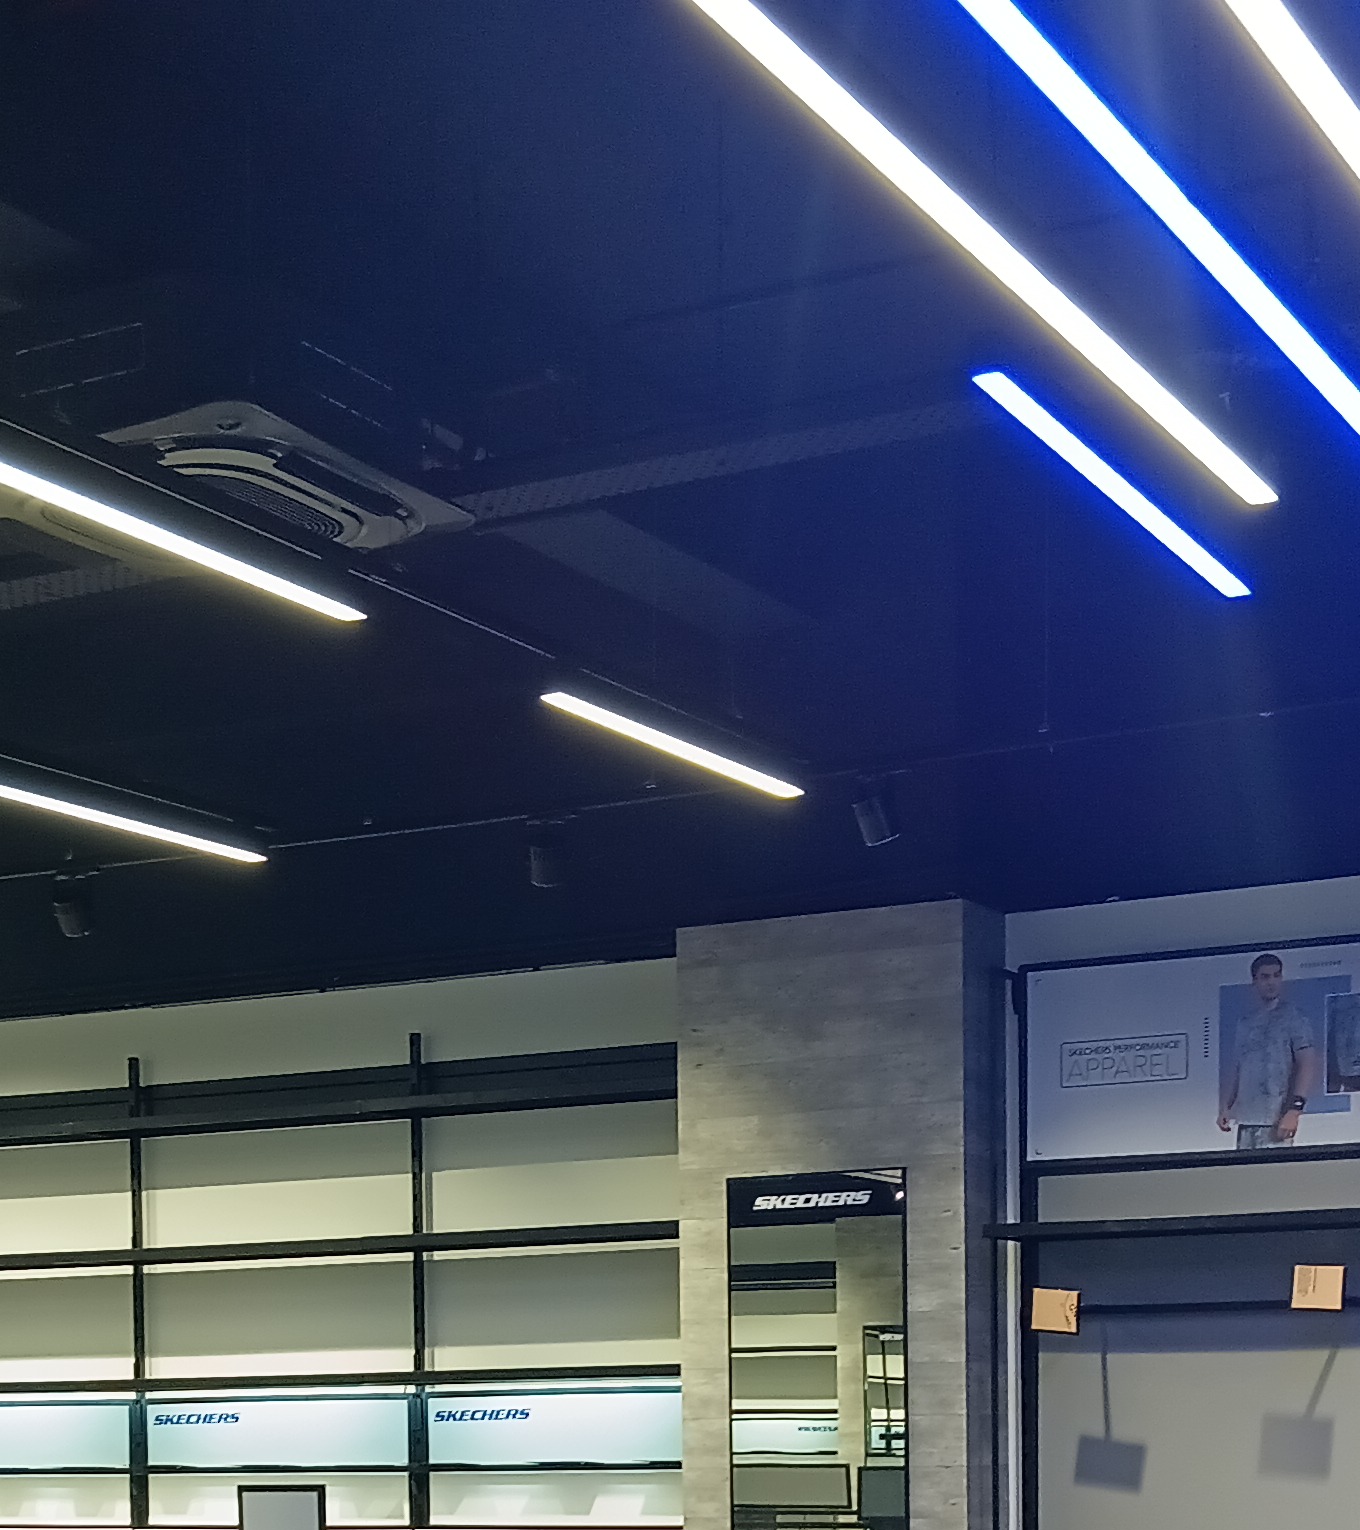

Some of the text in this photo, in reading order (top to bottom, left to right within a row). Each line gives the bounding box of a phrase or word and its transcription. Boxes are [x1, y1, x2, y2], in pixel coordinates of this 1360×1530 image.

[1067, 1053, 1180, 1081] APPAREL
[753, 1190, 872, 1210] SKECHERS
[153, 1412, 240, 1426] SKECHERS
[433, 1408, 531, 1422] SKECHERS
